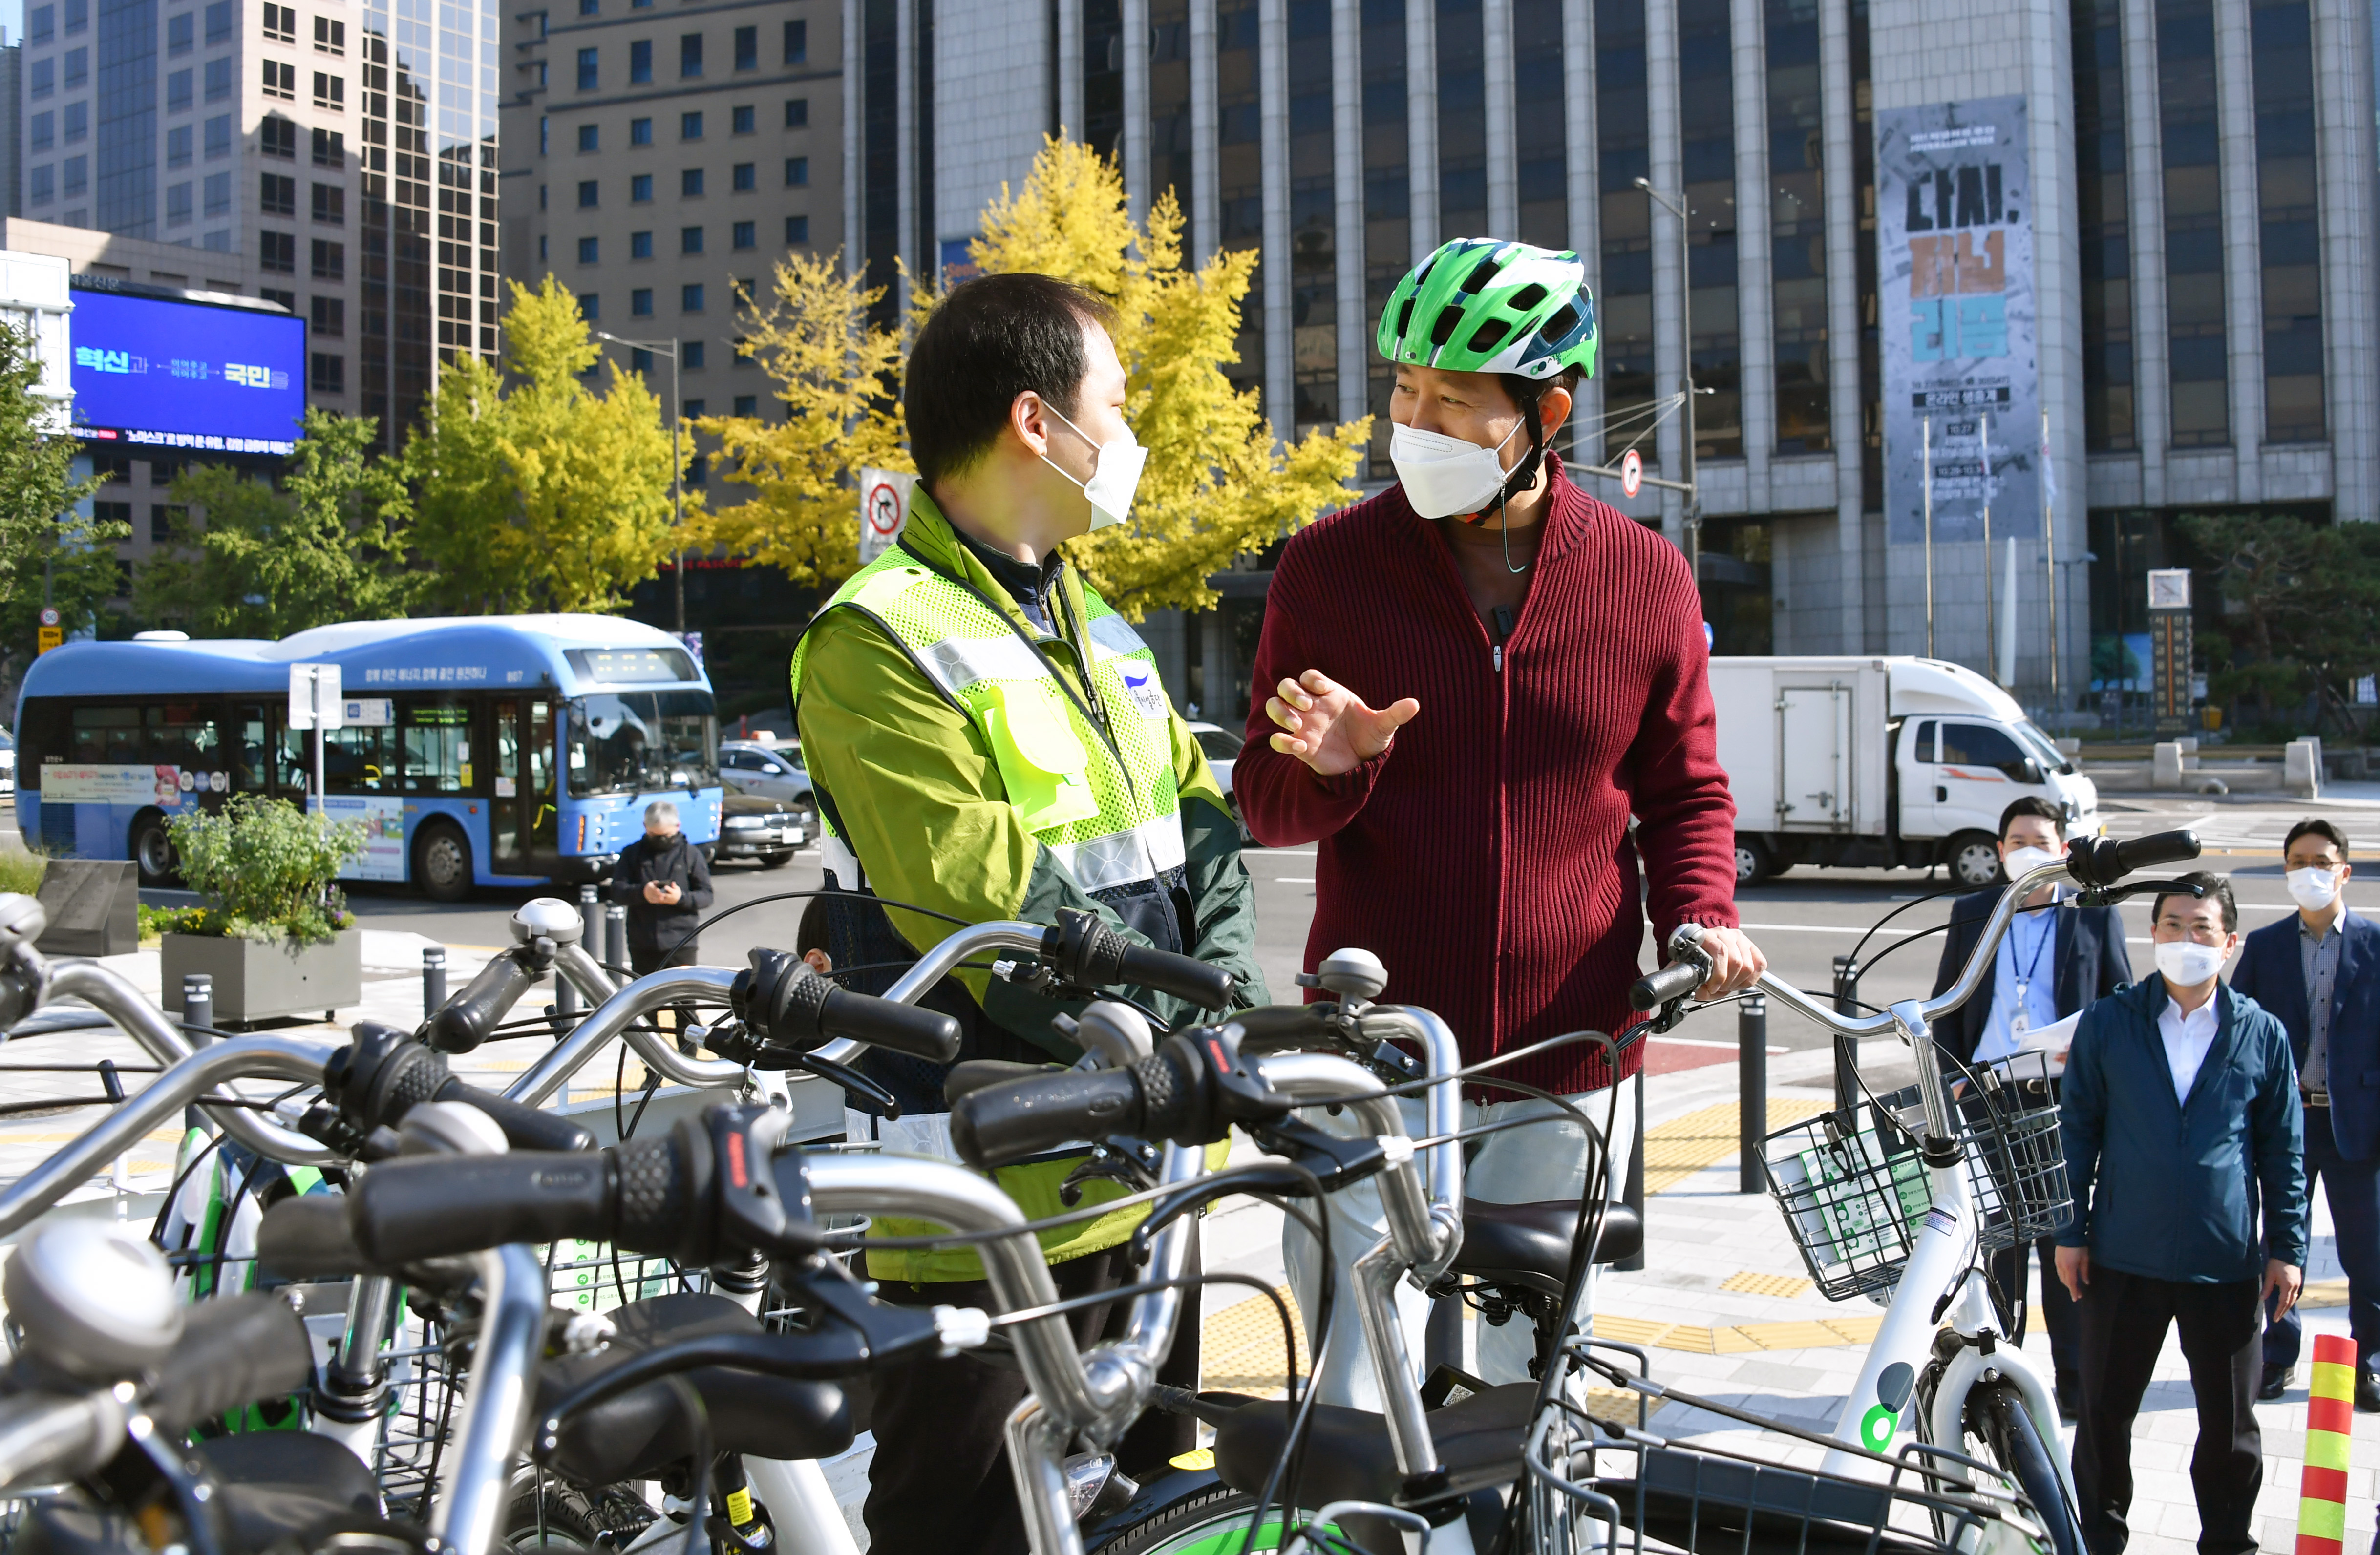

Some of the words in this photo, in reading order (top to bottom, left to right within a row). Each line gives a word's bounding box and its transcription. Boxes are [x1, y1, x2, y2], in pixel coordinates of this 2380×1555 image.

[1909, 230, 2006, 297] 저널
[1911, 296, 2008, 363] 리즘
[75, 346, 148, 375] 혁신과
[1133, 689, 1162, 710] 울시설공단
